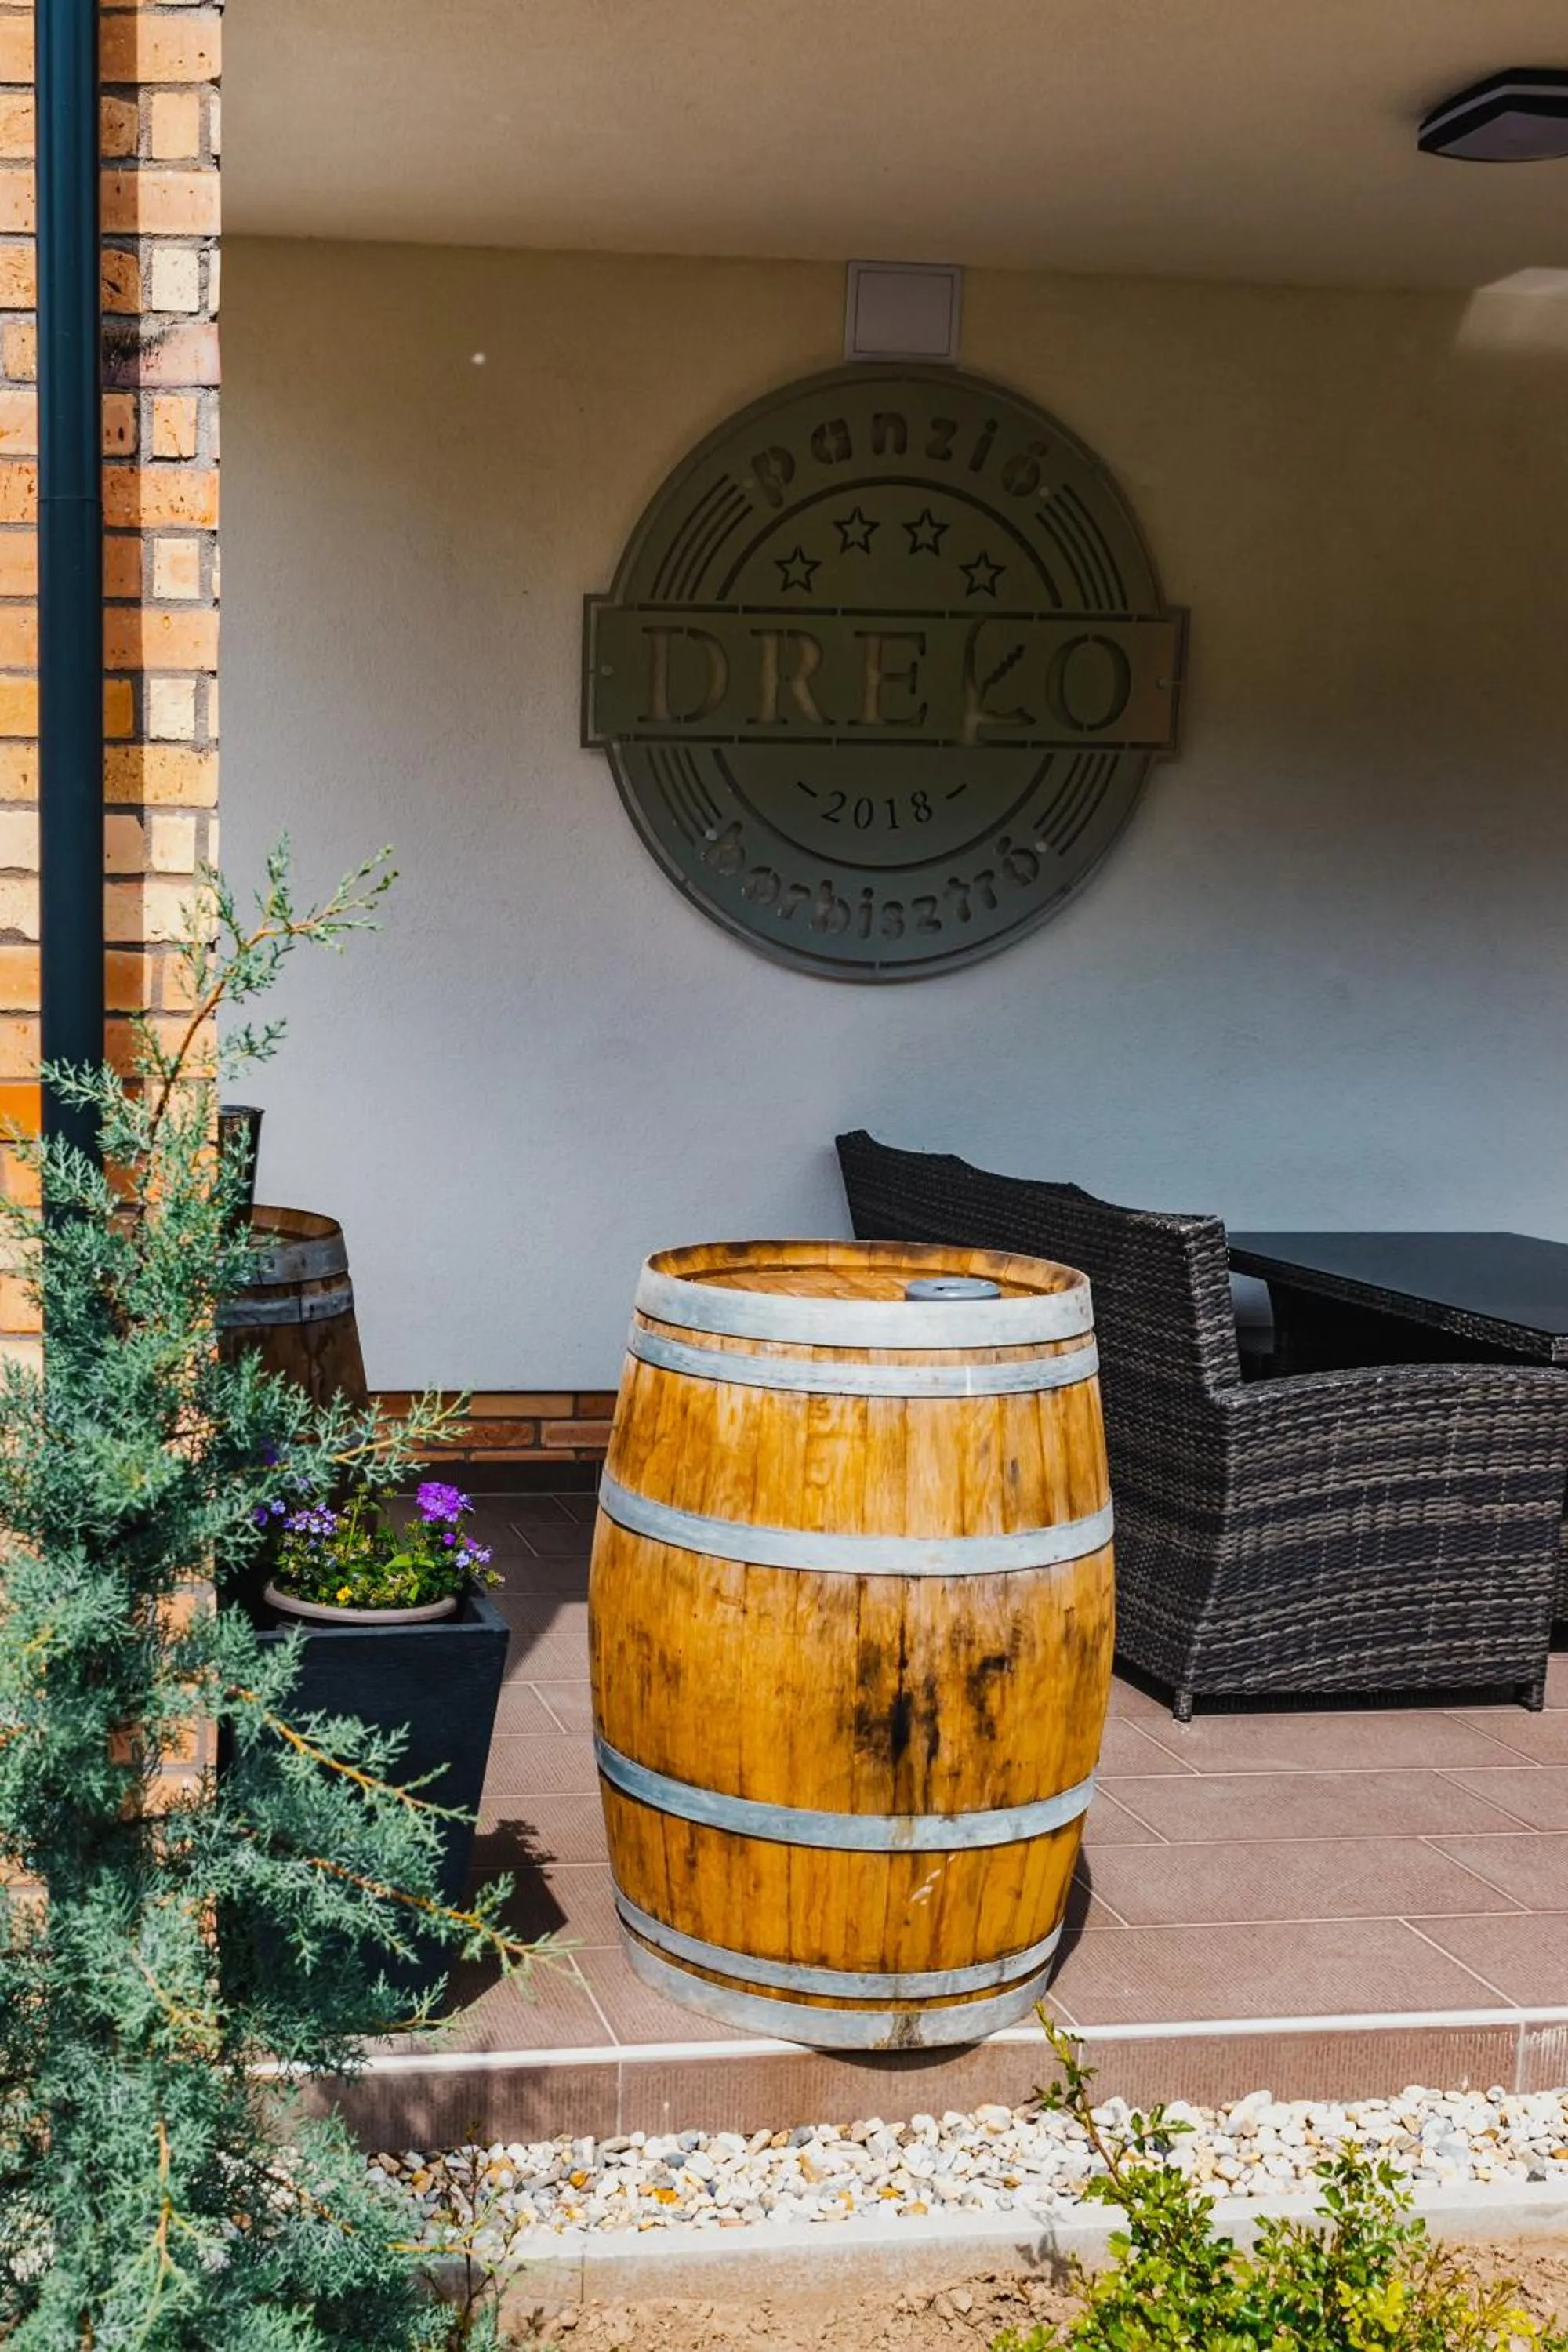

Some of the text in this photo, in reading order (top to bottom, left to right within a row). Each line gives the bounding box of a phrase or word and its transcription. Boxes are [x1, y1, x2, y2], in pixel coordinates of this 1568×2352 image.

[750, 412, 1051, 509] panzió
[818, 789, 934, 831] 2018
[703, 821, 1040, 939] borbisztró
